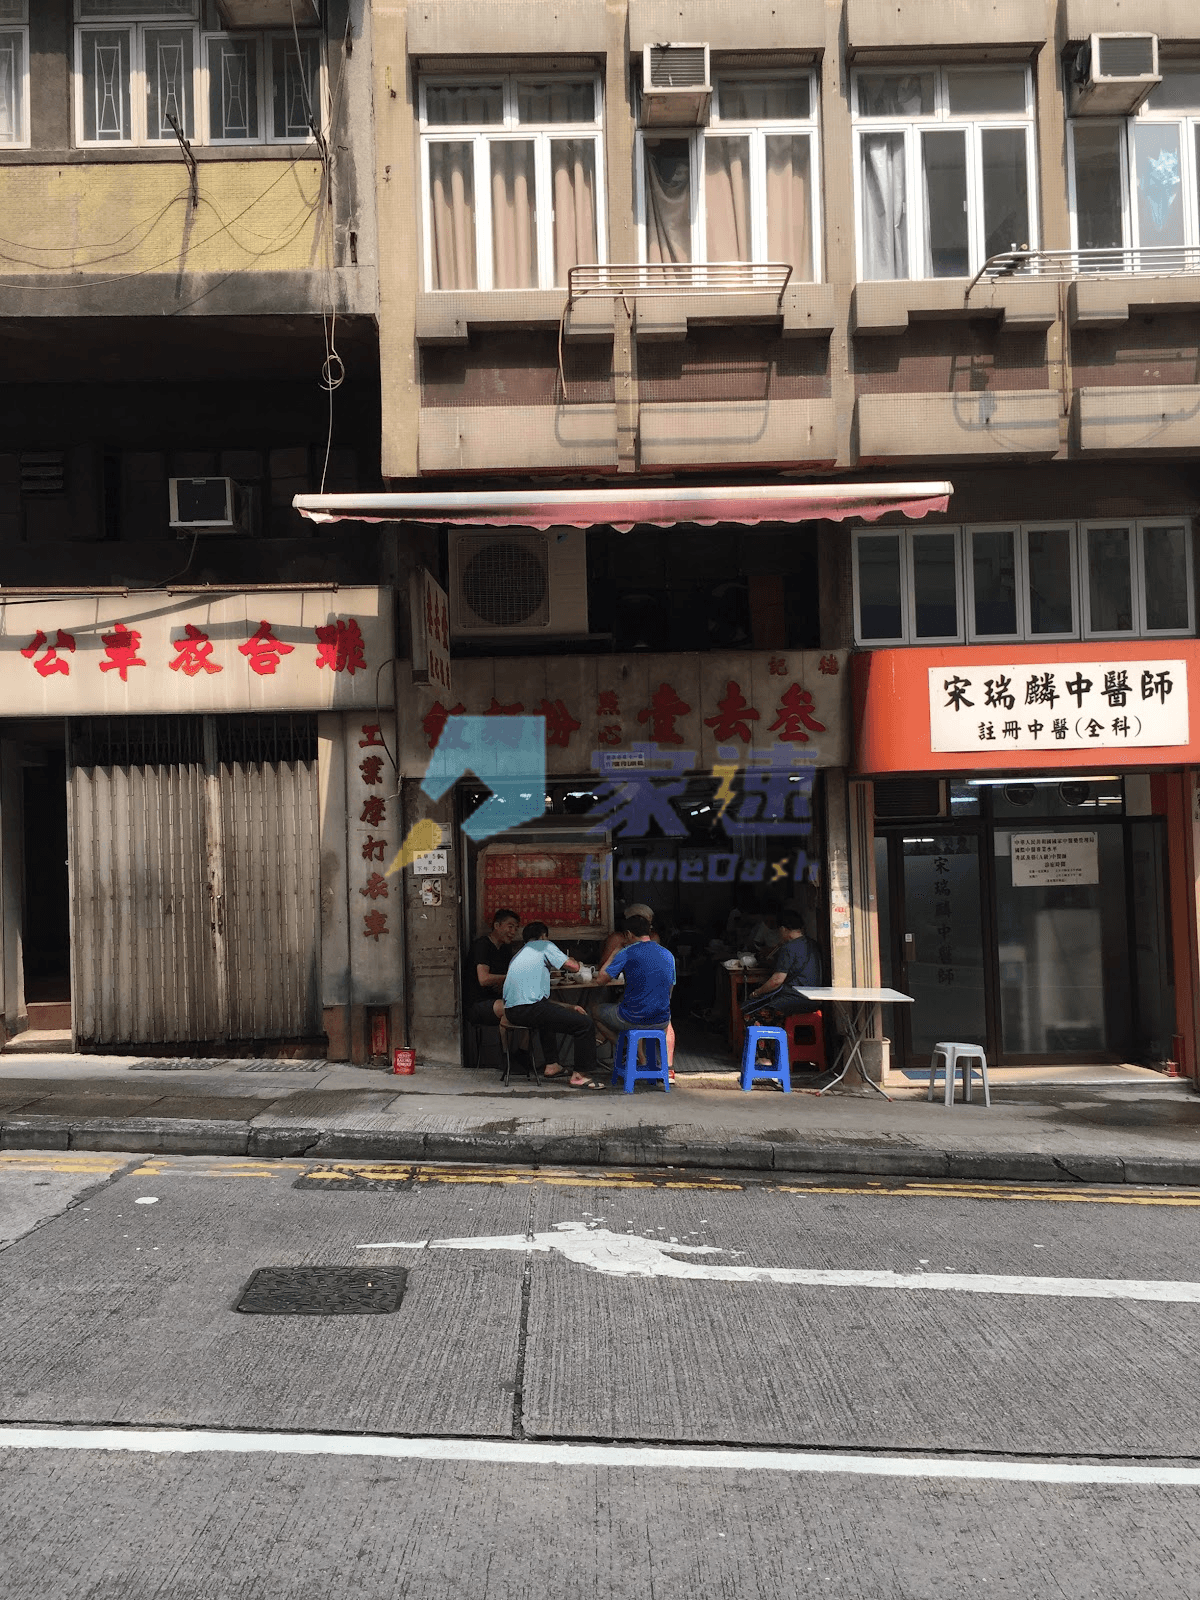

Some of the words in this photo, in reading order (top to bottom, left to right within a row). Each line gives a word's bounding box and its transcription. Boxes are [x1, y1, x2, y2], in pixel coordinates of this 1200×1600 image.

[943, 669, 1174, 712] 宋瑞麟中醫師
[978, 715, 1142, 741] 註冊中醫(全科)
[359, 724, 390, 942] 工業摩打衣車
